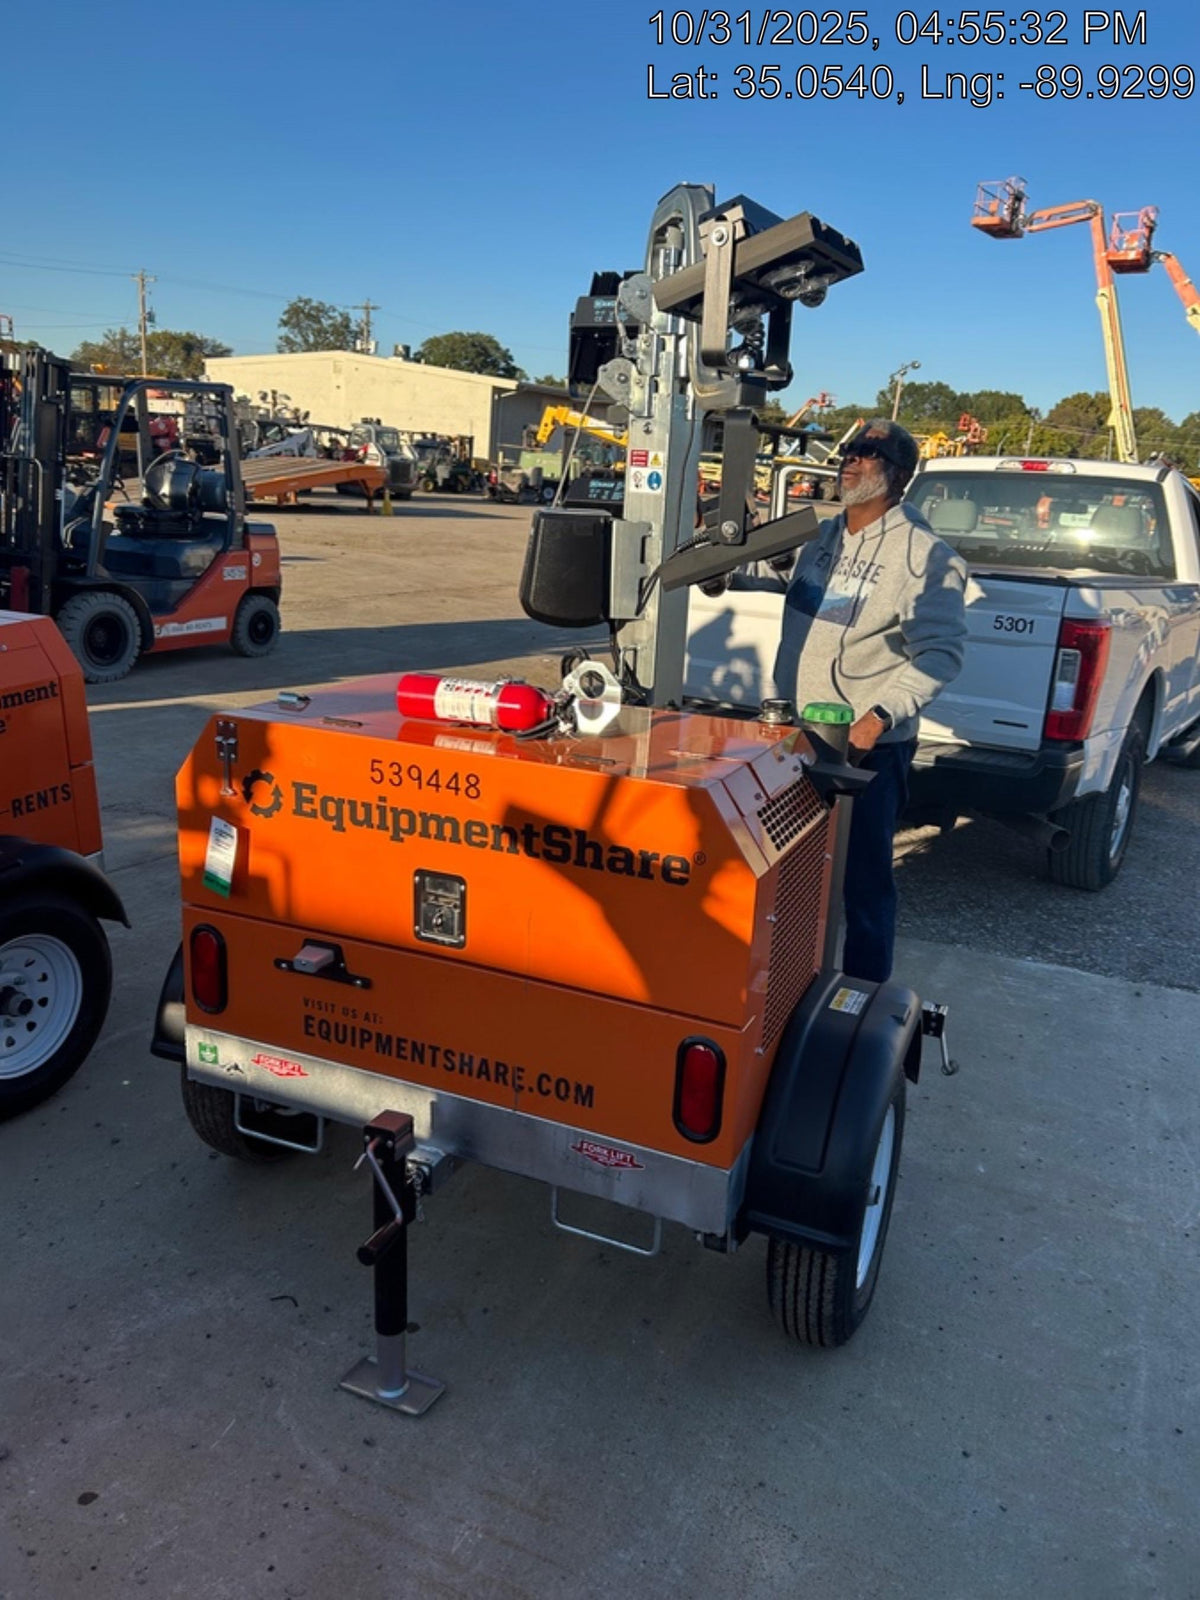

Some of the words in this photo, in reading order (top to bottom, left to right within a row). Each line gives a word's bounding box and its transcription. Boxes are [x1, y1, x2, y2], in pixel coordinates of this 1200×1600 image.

[993, 615, 1035, 634] 5301
[370, 759, 481, 799] 539448
[303, 997, 335, 1013] VISIT
[342, 1006, 357, 1018] US
[363, 1012, 383, 1024] AT:
[303, 1014, 595, 1109] EQUIPMENTSHARE.COM
[610, 1150, 632, 1163] LIFT
